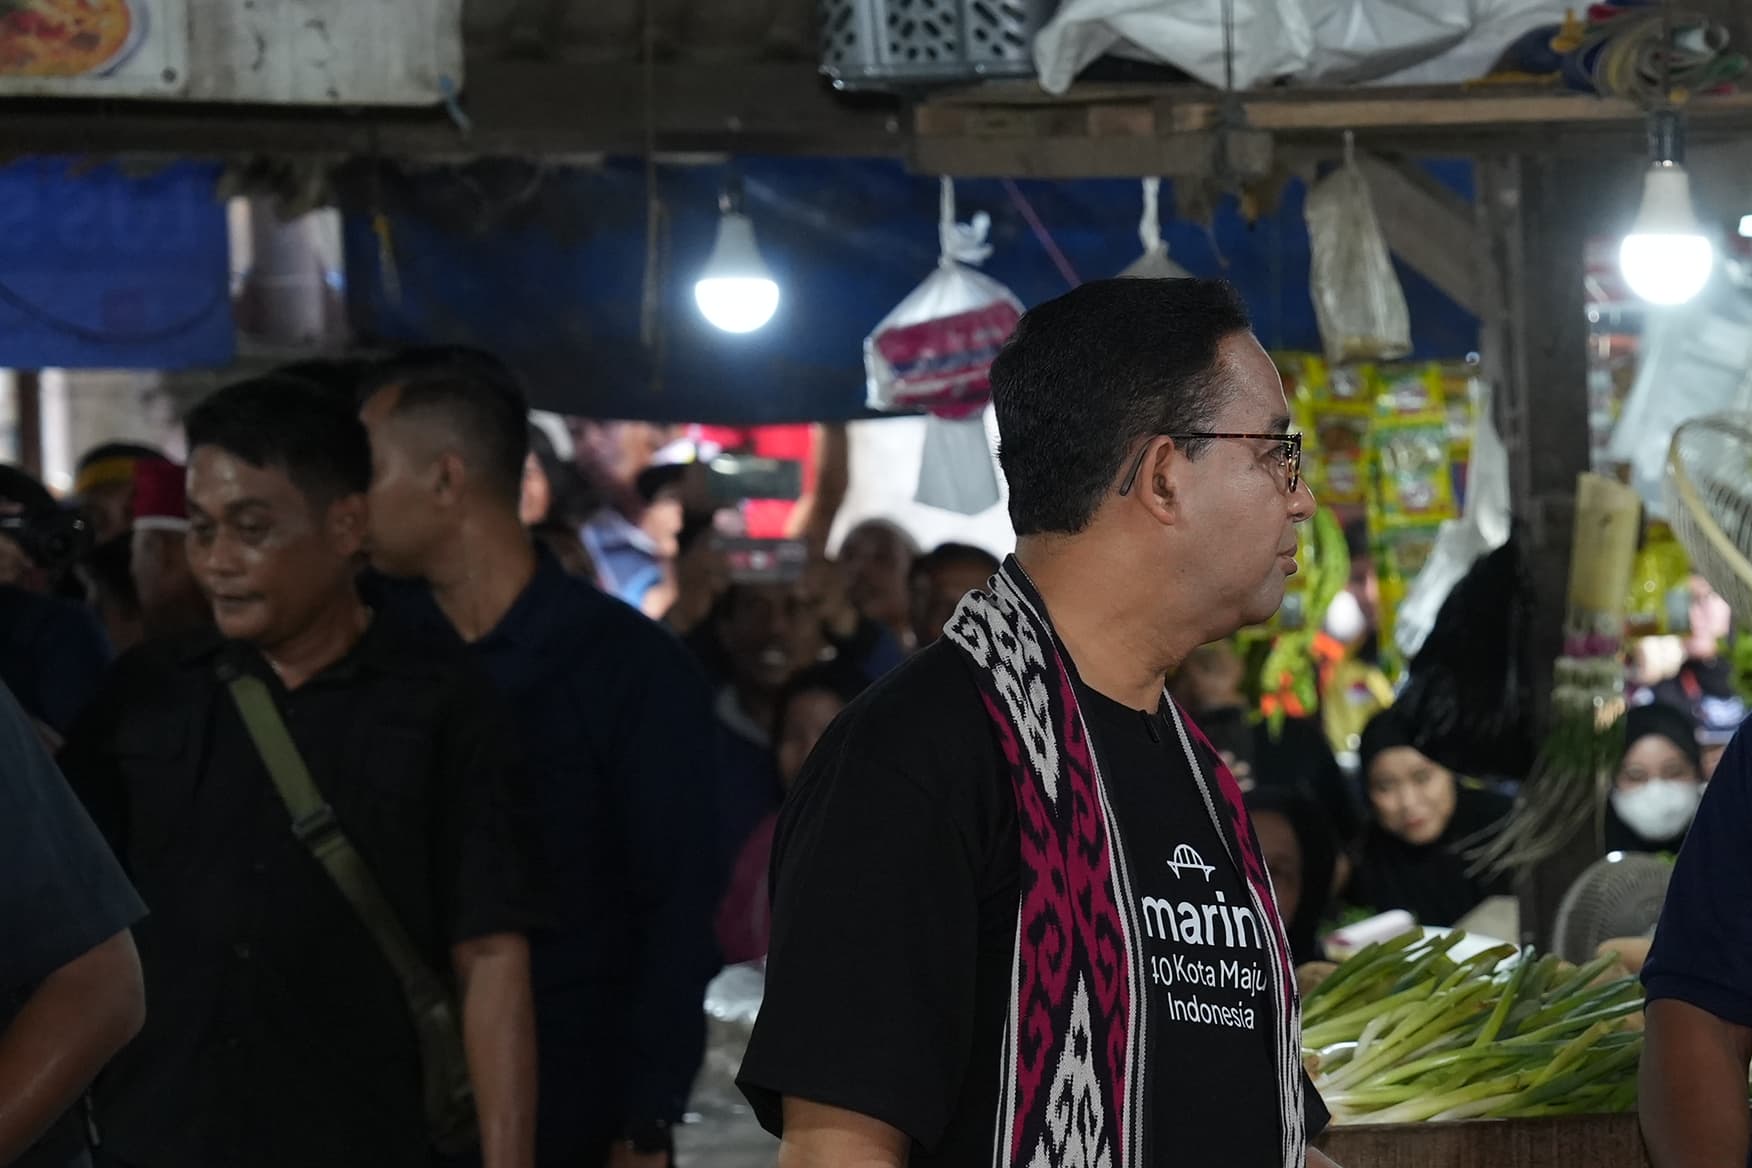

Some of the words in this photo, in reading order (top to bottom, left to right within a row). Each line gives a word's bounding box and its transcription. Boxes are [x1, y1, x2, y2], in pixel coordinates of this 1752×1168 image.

[1141, 891, 1262, 949] marin
[1173, 954, 1216, 987] Kota
[1219, 959, 1268, 997] Maju
[1167, 992, 1255, 1030] Indonesia
